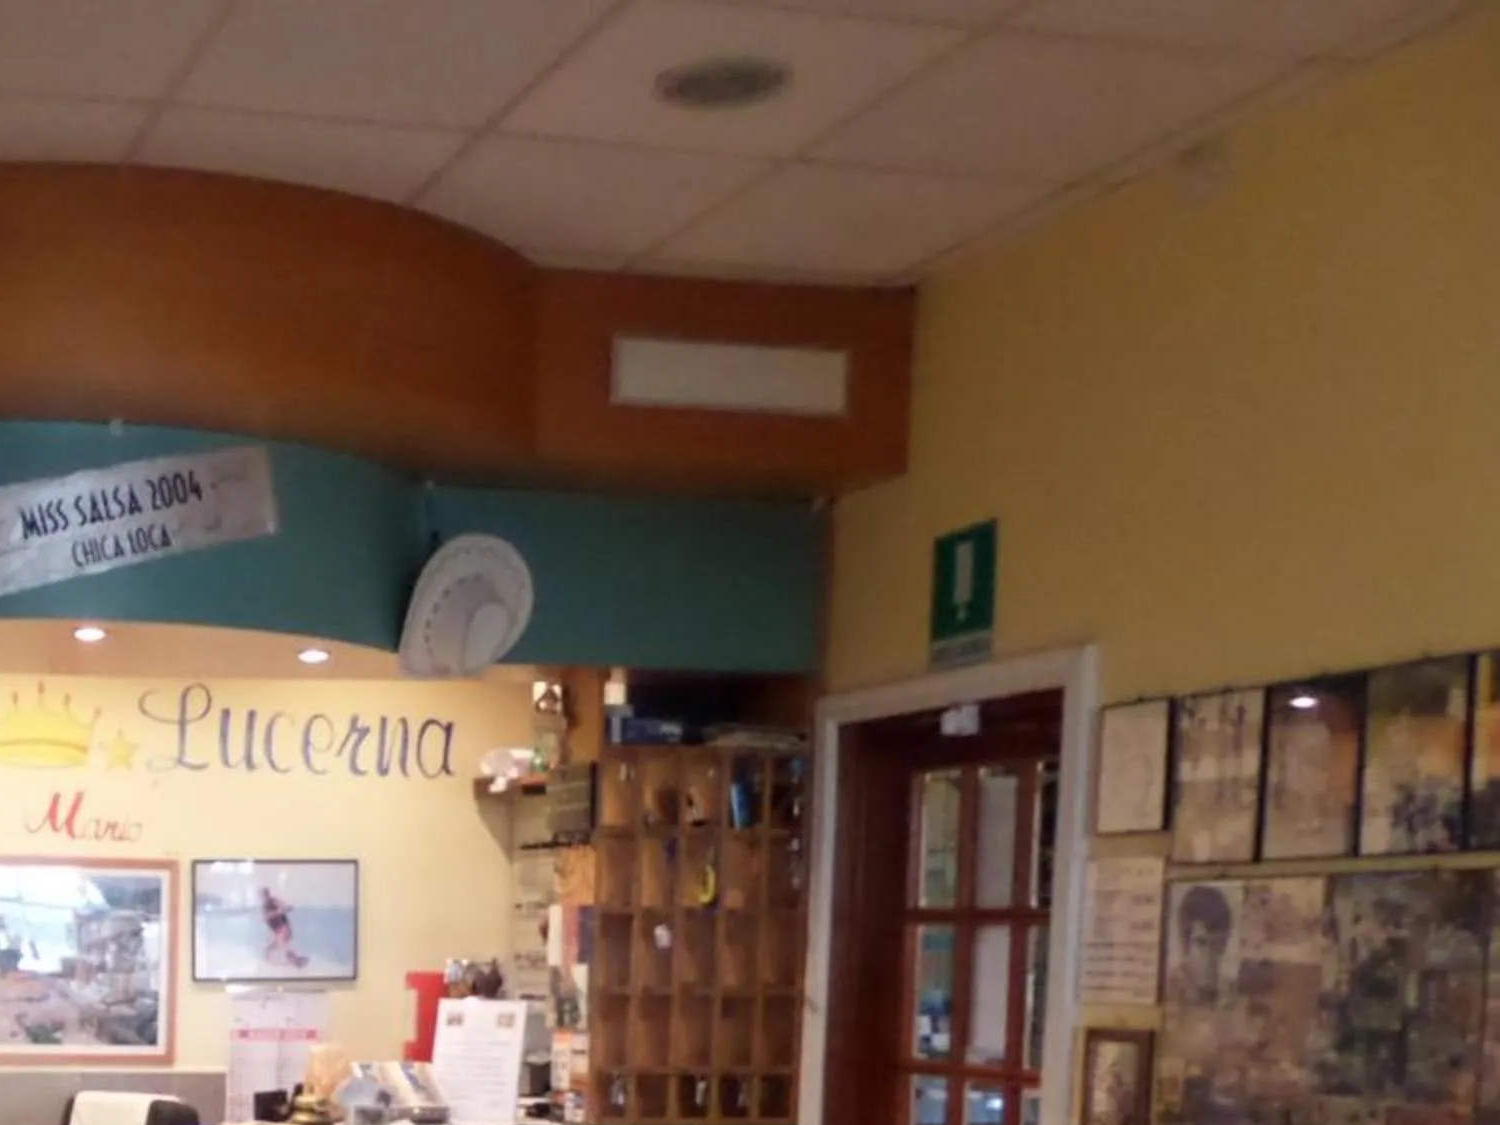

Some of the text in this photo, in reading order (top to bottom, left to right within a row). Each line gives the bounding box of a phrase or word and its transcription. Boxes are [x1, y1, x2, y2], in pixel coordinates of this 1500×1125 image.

[19, 469, 203, 540] MISS SALSA 2004
[72, 523, 172, 567] CHICA LOCA
[138, 682, 457, 779] Lucerna
